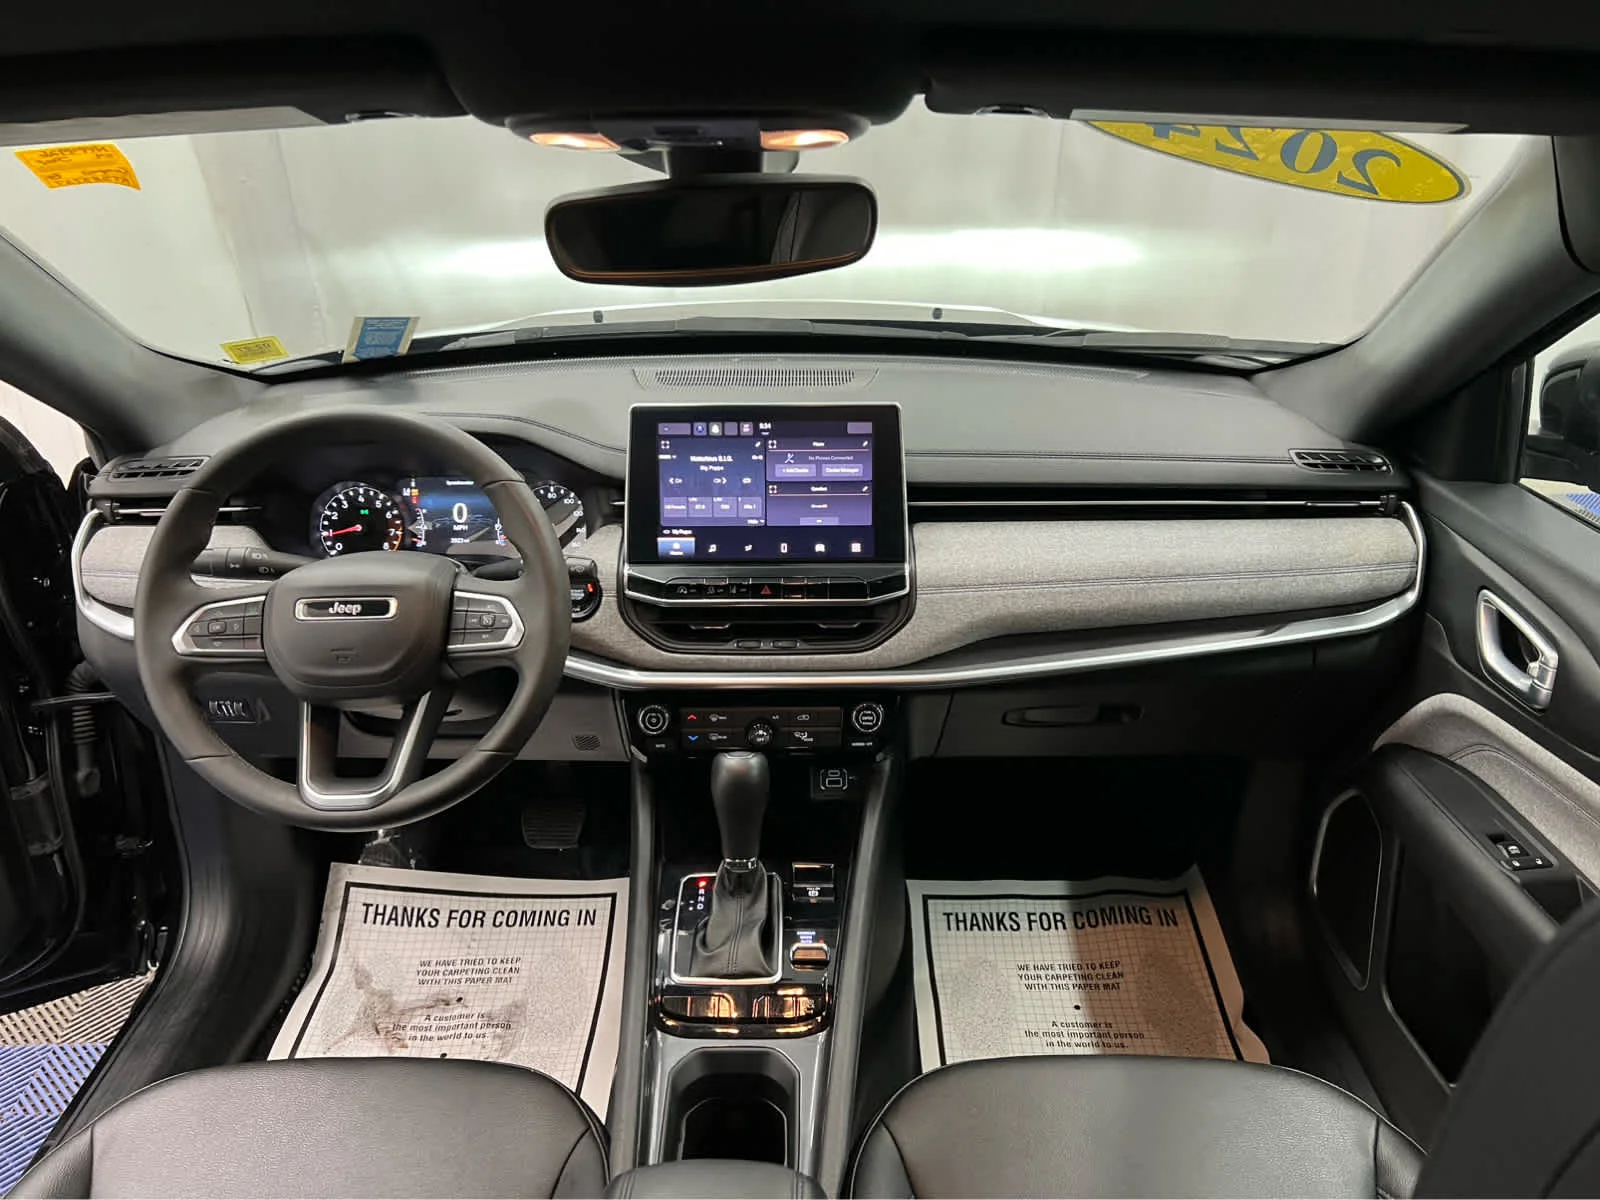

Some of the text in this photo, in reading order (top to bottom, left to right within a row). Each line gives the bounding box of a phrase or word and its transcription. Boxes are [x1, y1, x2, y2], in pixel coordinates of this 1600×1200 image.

[358, 494, 365, 503] 4
[341, 500, 349, 509] 3
[375, 500, 382, 509] 5
[331, 511, 339, 520] 2
[385, 511, 393, 519] 6
[452, 502, 468, 524] 0
[388, 528, 396, 536] 7
[335, 542, 343, 551] 0
[382, 542, 390, 550] 8
[329, 602, 362, 616] Jeep
[362, 902, 597, 928] THANKS FOR COMING IN
[942, 906, 1178, 932] THANKS FOR COMING IN
[435, 959, 457, 967] HAVE
[460, 958, 484, 966] TRIED
[500, 957, 521, 965] KEEP
[1017, 960, 1120, 971] WE HAVE TRIED TO KEEP
[416, 966, 520, 977] YOUR CARPETING CLEAN
[1017, 971, 1124, 981] YOUR CARPETING CLEAN
[494, 976, 512, 984] MAT
[1024, 982, 1120, 991] WITH THIS PAPER MAT
[433, 1013, 474, 1021] customer
[392, 1022, 512, 1032] the most important person
[1051, 1020, 1113, 1029] A customer is
[420, 1033, 434, 1041] the
[437, 1032, 462, 1041] world
[1024, 1030, 1145, 1040] the most important person
[1057, 1040, 1072, 1048] the
[1074, 1041, 1100, 1049] world
[1102, 1041, 1112, 1049] to
[1114, 1041, 1129, 1049] us.
